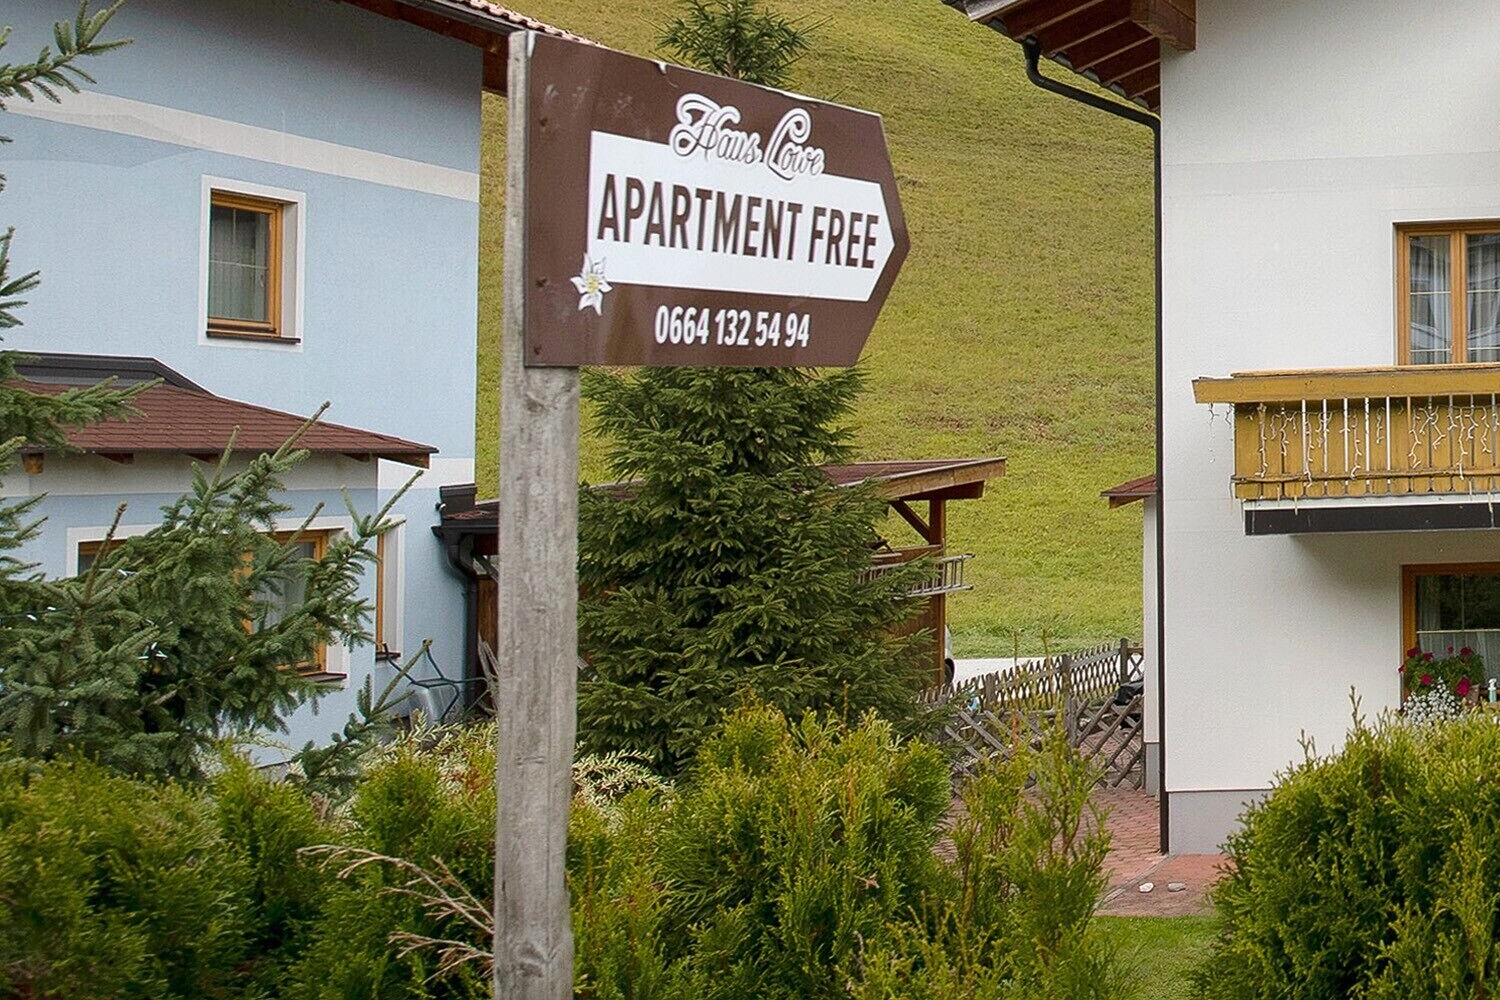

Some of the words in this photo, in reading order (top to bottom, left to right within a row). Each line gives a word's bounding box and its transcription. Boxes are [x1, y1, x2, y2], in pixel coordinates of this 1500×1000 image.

[669, 93, 762, 164] Haus
[597, 173, 803, 261] APARTMENT
[808, 206, 880, 269] FREE
[655, 305, 710, 344] 0664
[714, 309, 751, 346] 132
[755, 311, 781, 347] 54
[784, 312, 810, 348] 94
